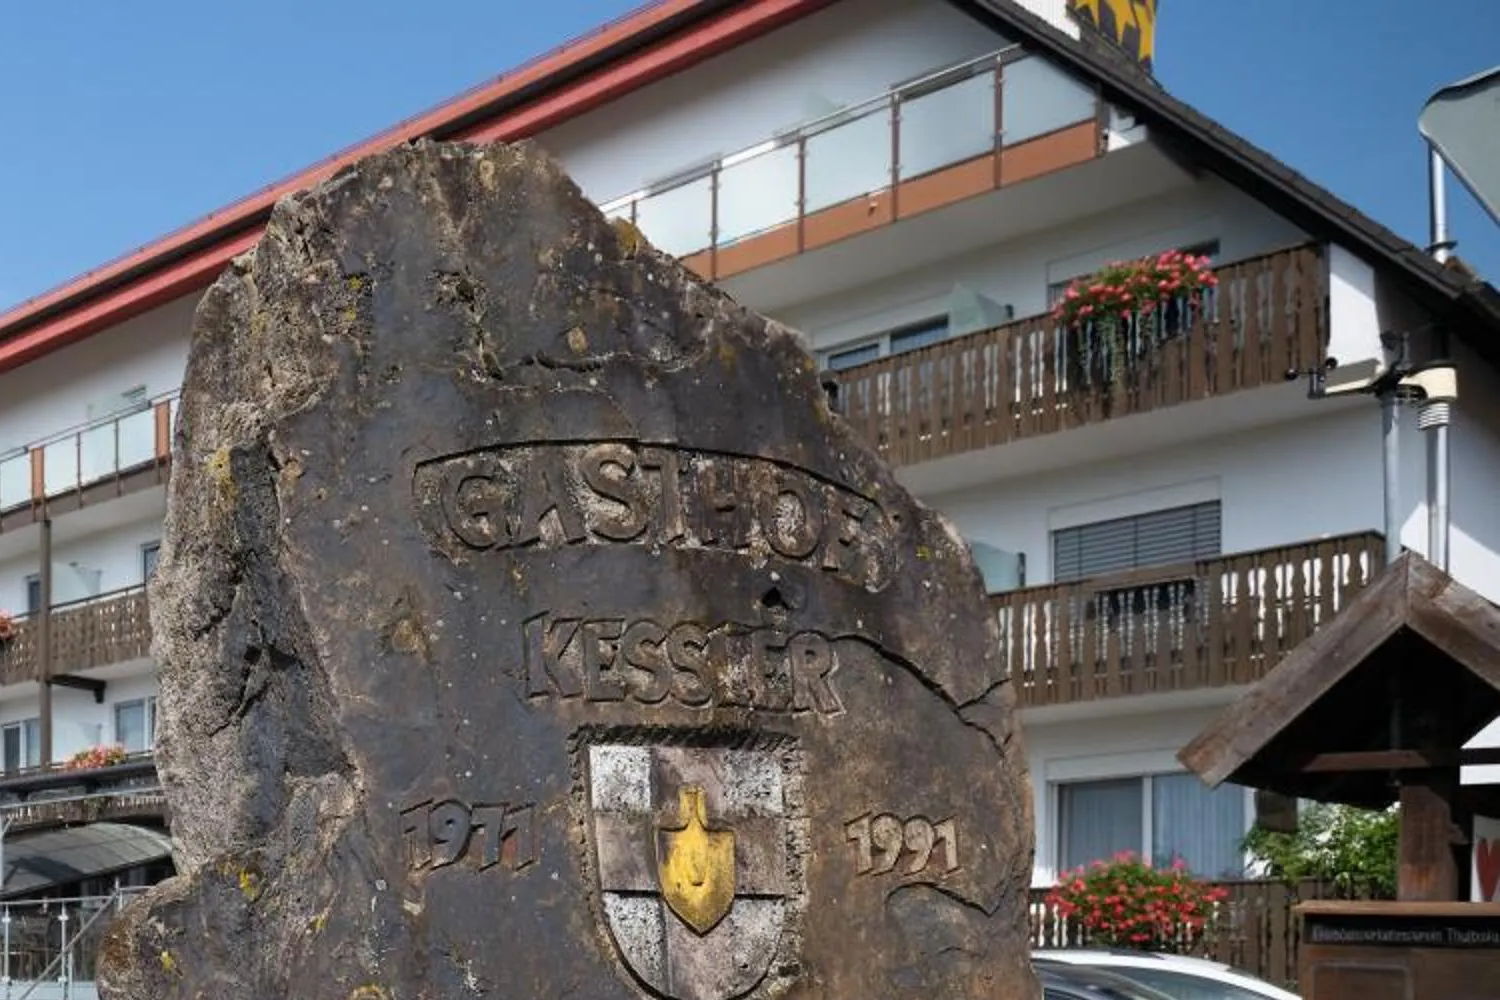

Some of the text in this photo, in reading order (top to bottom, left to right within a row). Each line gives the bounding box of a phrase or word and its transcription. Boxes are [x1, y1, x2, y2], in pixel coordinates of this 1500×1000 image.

[438, 442, 874, 576] GASTHOF
[522, 610, 846, 714] KESSLER
[843, 811, 963, 877] 1991
